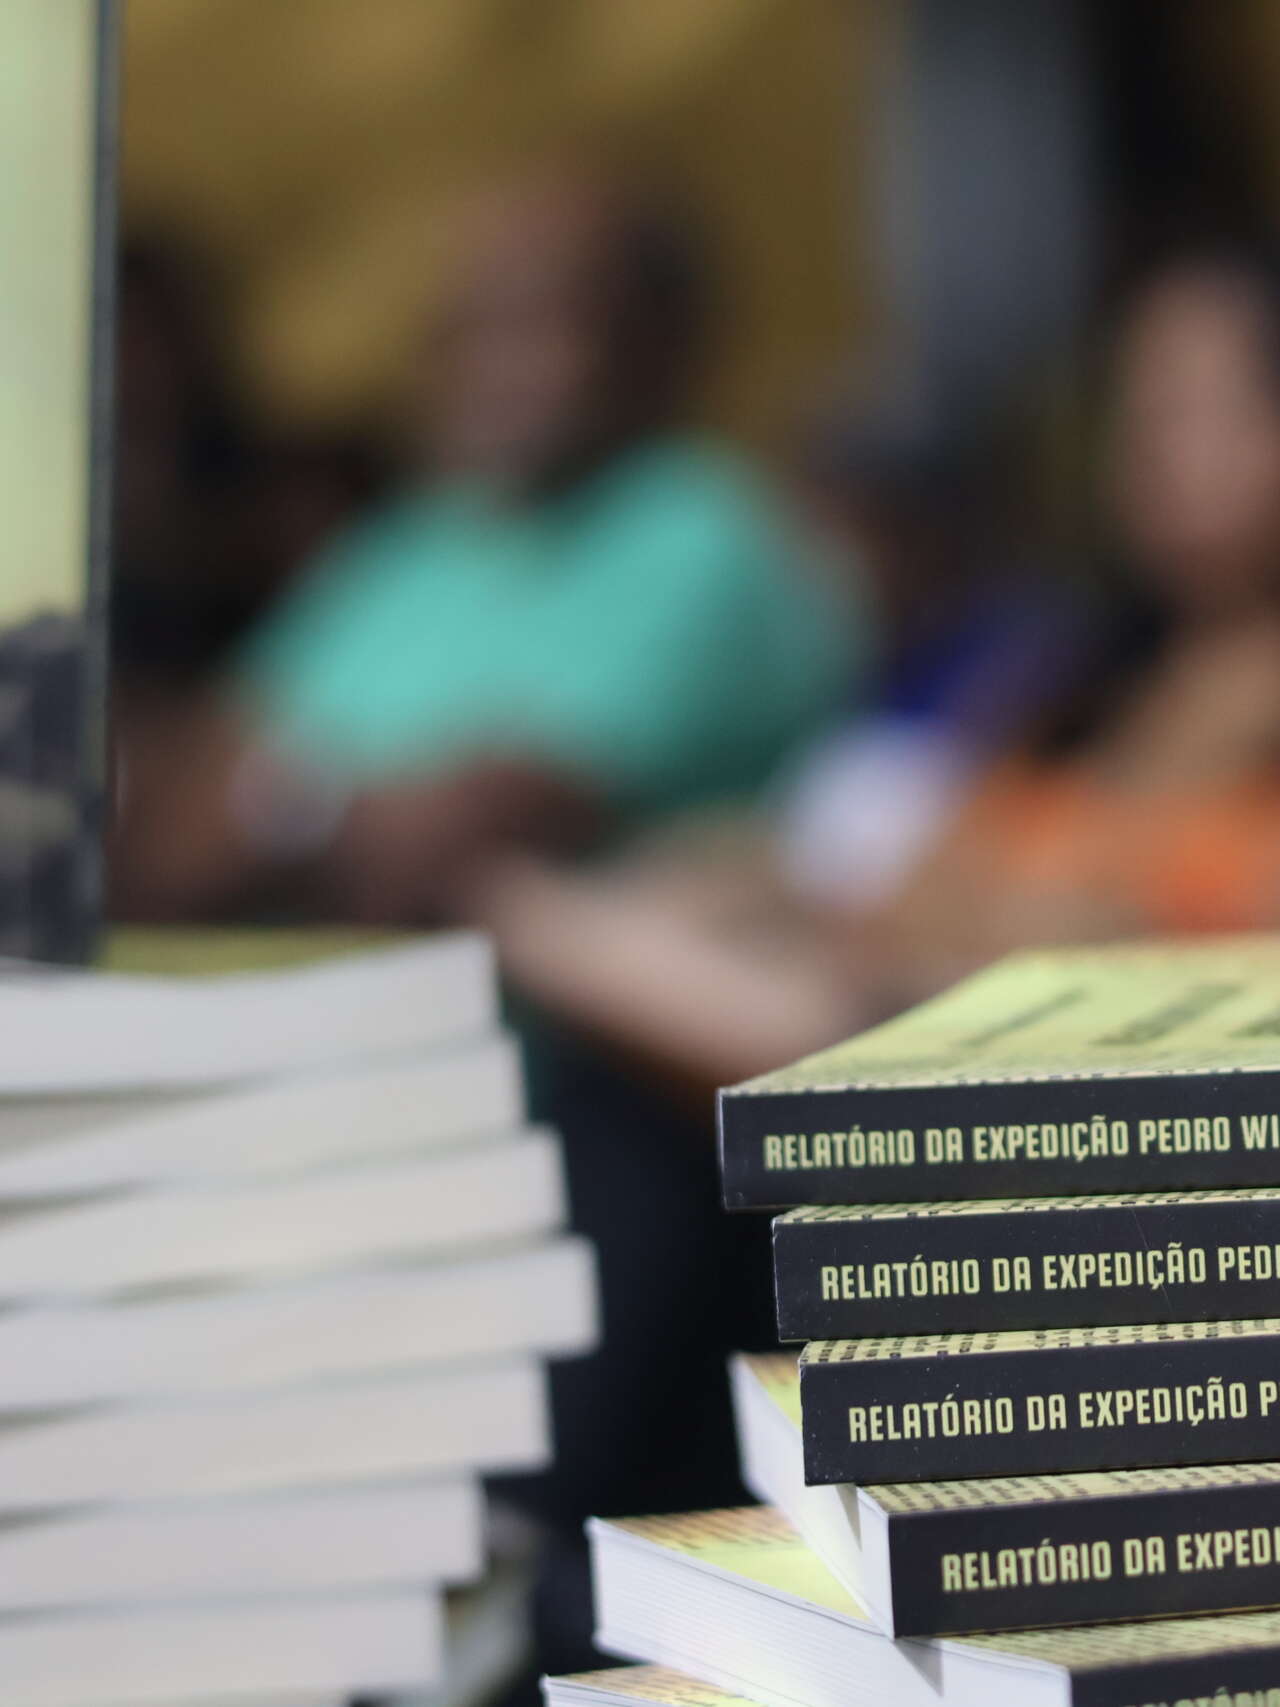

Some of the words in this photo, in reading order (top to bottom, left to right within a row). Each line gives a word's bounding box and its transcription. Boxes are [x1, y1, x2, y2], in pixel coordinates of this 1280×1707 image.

[763, 1124, 916, 1170] RELATÓRIO
[924, 1127, 964, 1165] DA
[972, 1114, 1130, 1163] EXPEDIÇÃO
[1138, 1116, 1232, 1155] PEDRO
[821, 1254, 981, 1301] RELATÓRIO
[991, 1256, 1032, 1293] DA
[1042, 1241, 1207, 1291] EXPEDIÇÃO
[848, 1393, 1014, 1443] RELATÓRIO
[1026, 1393, 1067, 1432] DA
[1078, 1376, 1248, 1429] EXPEDIÇÃO
[941, 1538, 1112, 1592] RELATÓRIO
[1123, 1536, 1166, 1577] DA
